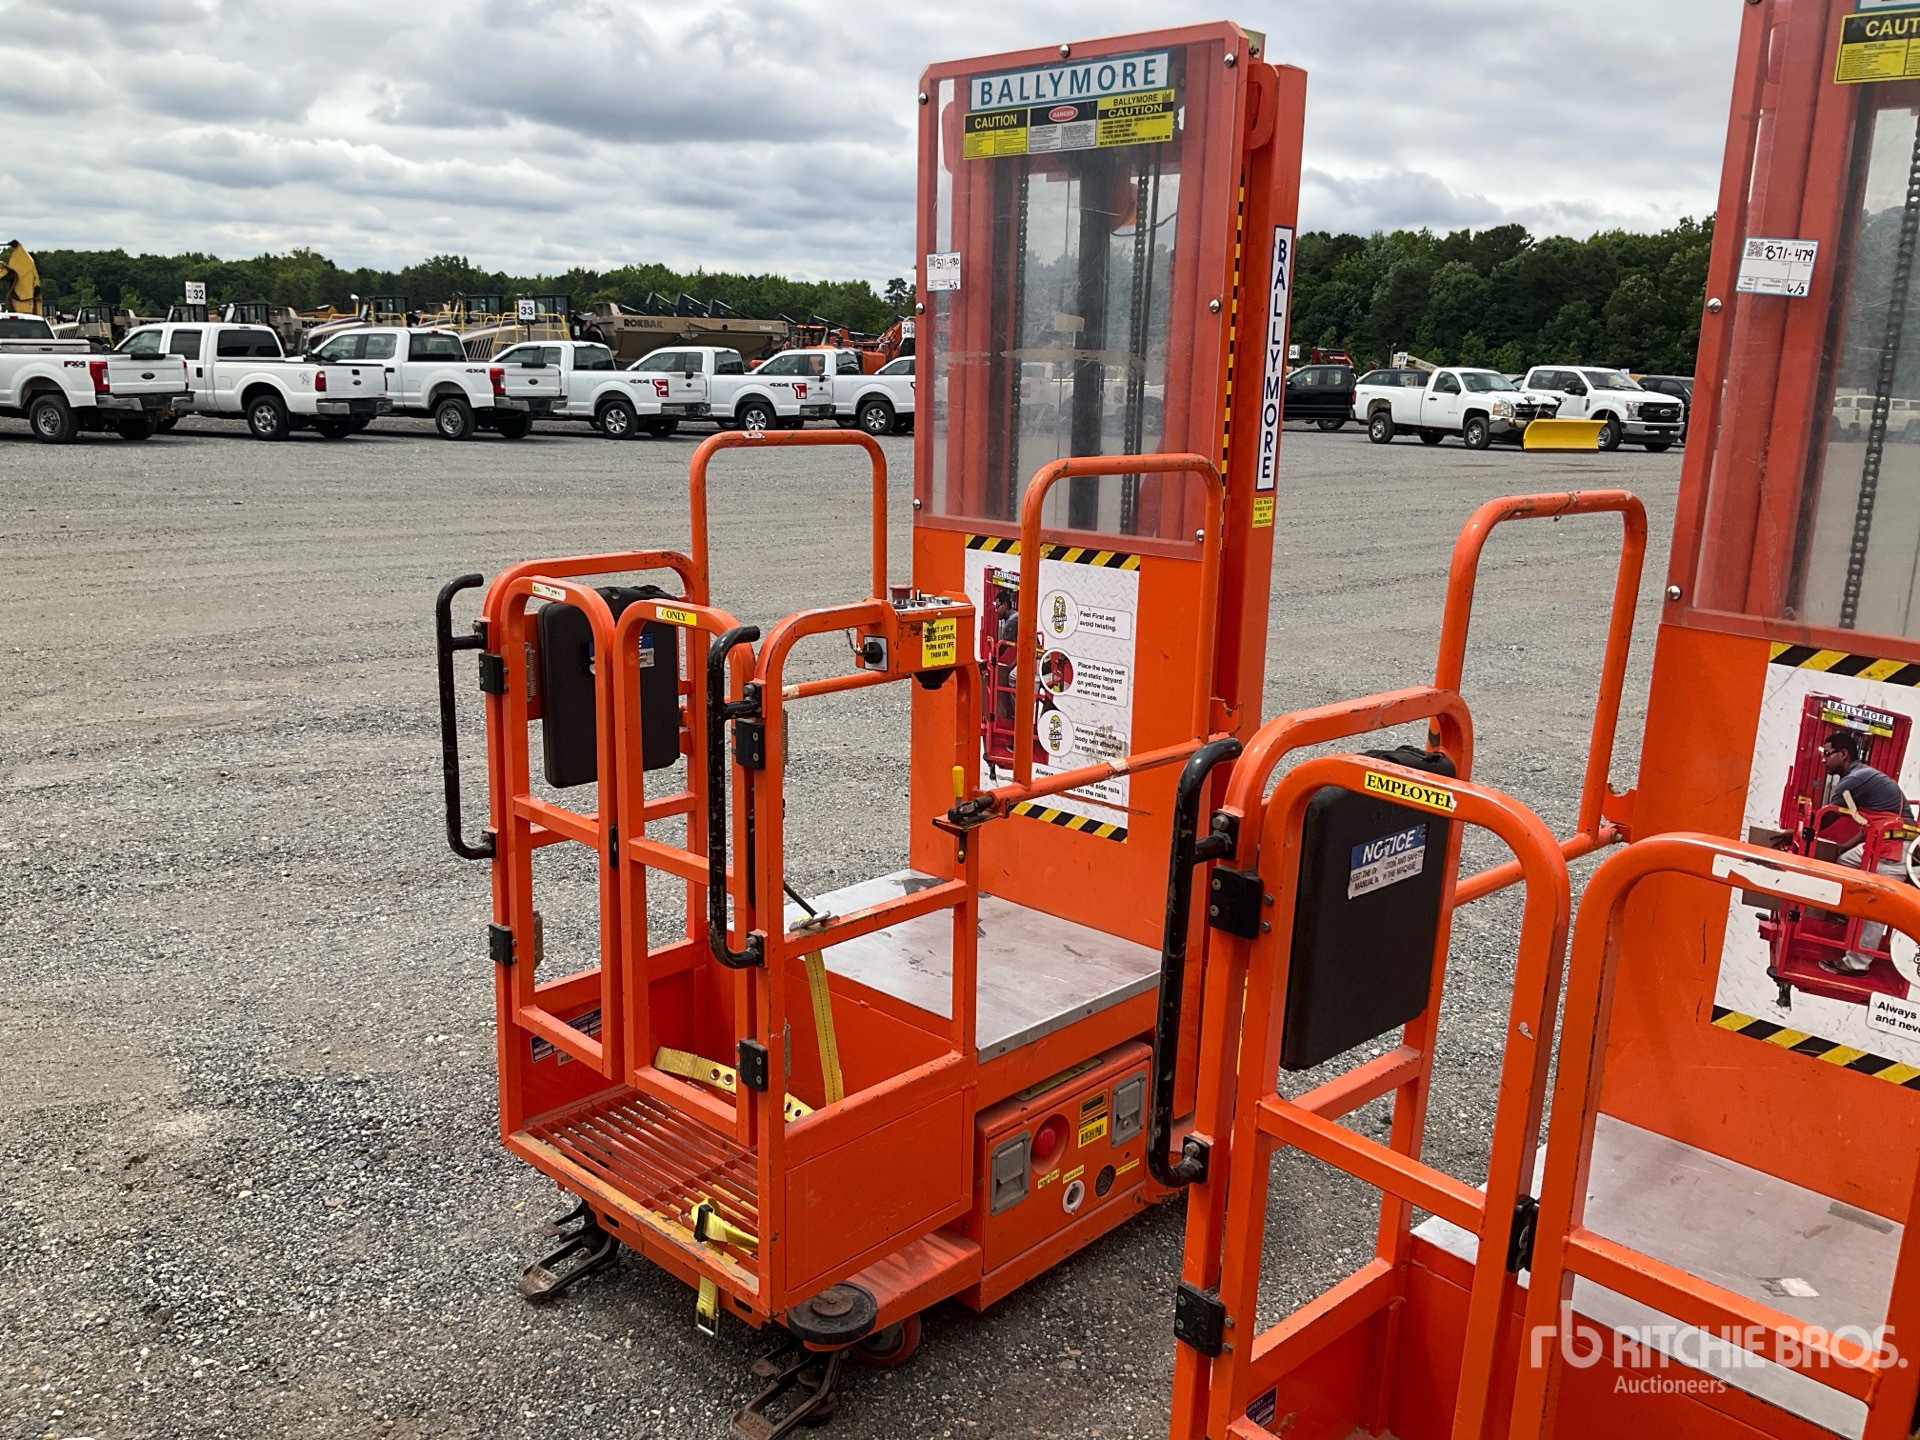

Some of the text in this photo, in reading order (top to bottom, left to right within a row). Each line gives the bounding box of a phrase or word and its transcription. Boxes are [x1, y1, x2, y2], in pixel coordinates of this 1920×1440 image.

[980, 58, 1157, 106] BALLYMORE
[1113, 94, 1158, 107] BALLYMORE
[1108, 104, 1163, 118] CAUTION
[974, 114, 1018, 129] CAUTION
[193, 289, 204, 300] 32
[520, 306, 533, 315] 33
[624, 319, 663, 329] ROKBAK
[1261, 238, 1286, 479] BALLYMORE
[1397, 354, 1407, 363] 37
[666, 609, 687, 622] ONLY
[1092, 612, 1105, 620] First
[1079, 620, 1117, 632] avoid twisting.
[926, 643, 937, 651] TURN
[930, 651, 941, 659] THEN
[1077, 661, 1092, 670] Place
[1101, 666, 1114, 675] body
[1115, 668, 1125, 676] belt
[1088, 673, 1102, 681] static
[1103, 675, 1123, 685] lanyard
[1085, 681, 1101, 690] yellow
[1102, 683, 1115, 692] hook
[1091, 690, 1100, 698] not
[1829, 701, 1891, 724] BALLYMORE
[1075, 726, 1094, 736] Always
[1075, 735, 1089, 744] body
[1099, 740, 1122, 751] attached
[1081, 746, 1095, 754] static
[1095, 783, 1107, 792] side
[1108, 786, 1120, 795] rails
[1362, 829, 1416, 864] NOTICE
[1877, 1001, 1917, 1020] Always
[1875, 1014, 1896, 1026] and
